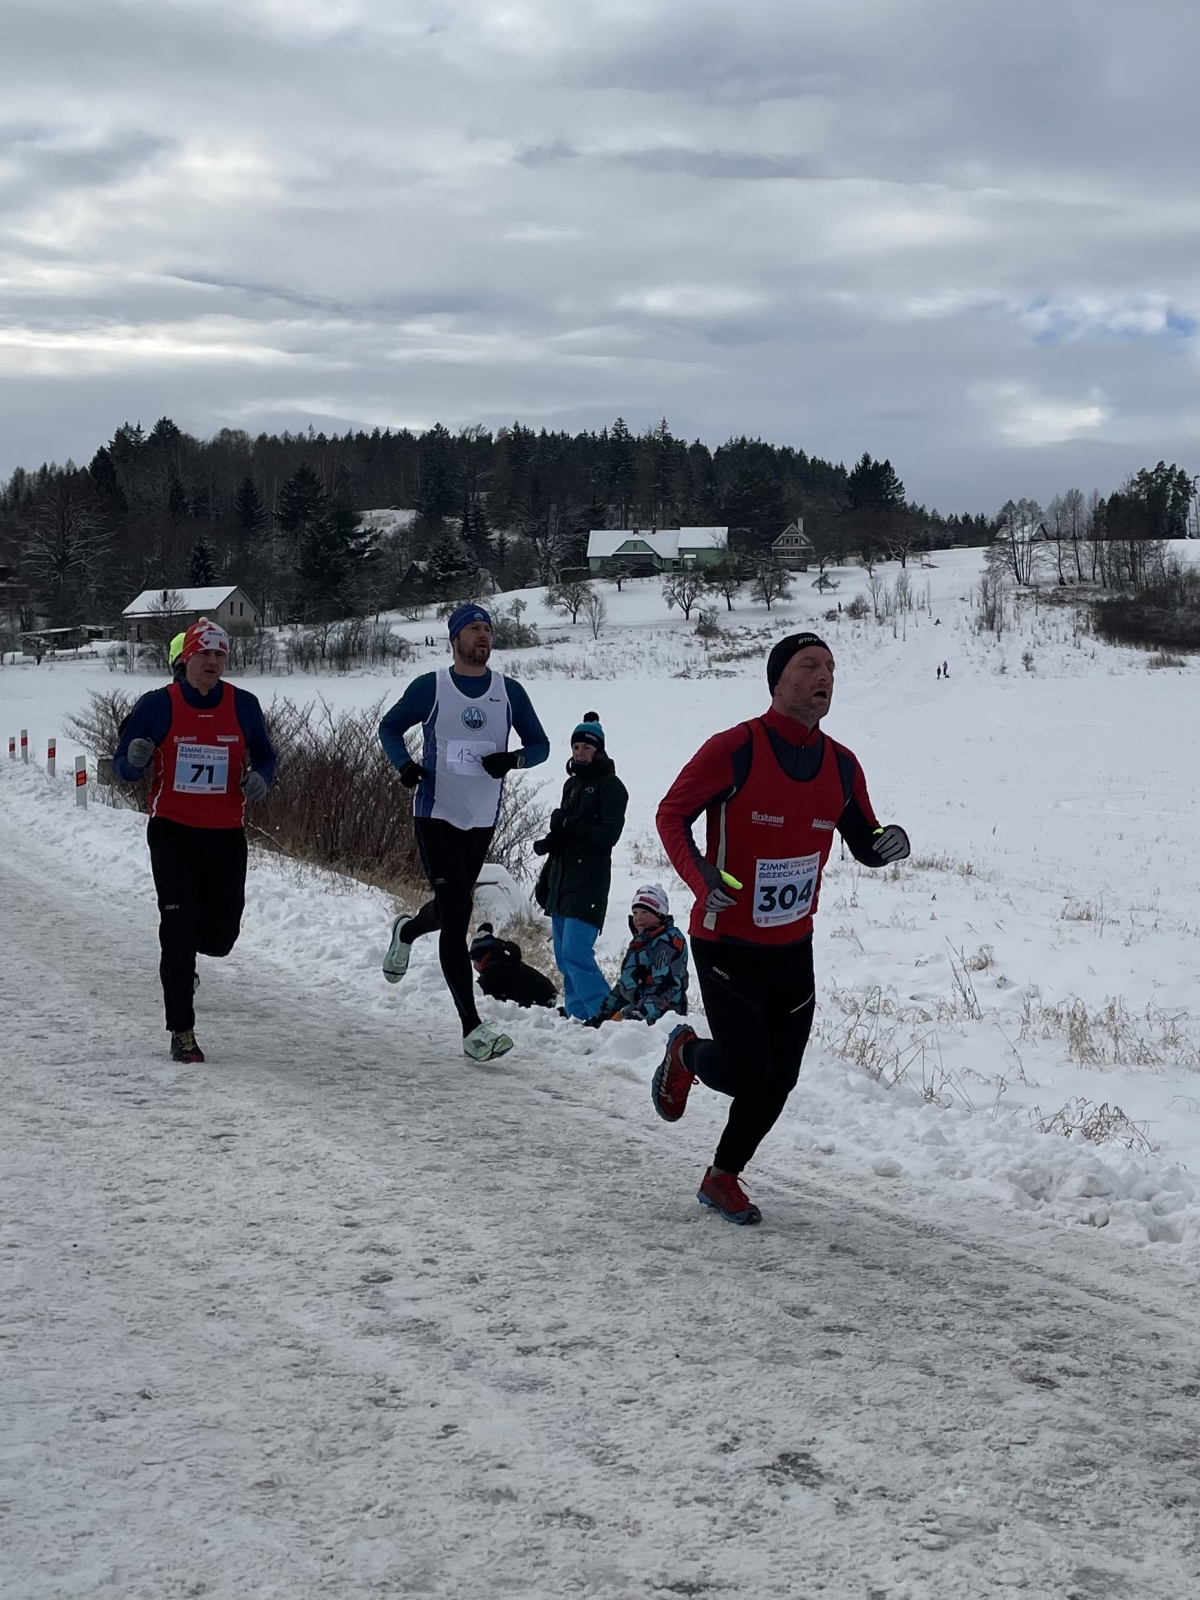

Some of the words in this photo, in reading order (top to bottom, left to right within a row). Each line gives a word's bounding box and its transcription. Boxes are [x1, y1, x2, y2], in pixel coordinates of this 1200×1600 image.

[190, 764, 215, 784] 71
[759, 860, 789, 871] ZIMNÍ
[802, 865, 817, 875] LIGA
[757, 878, 814, 913] 304
